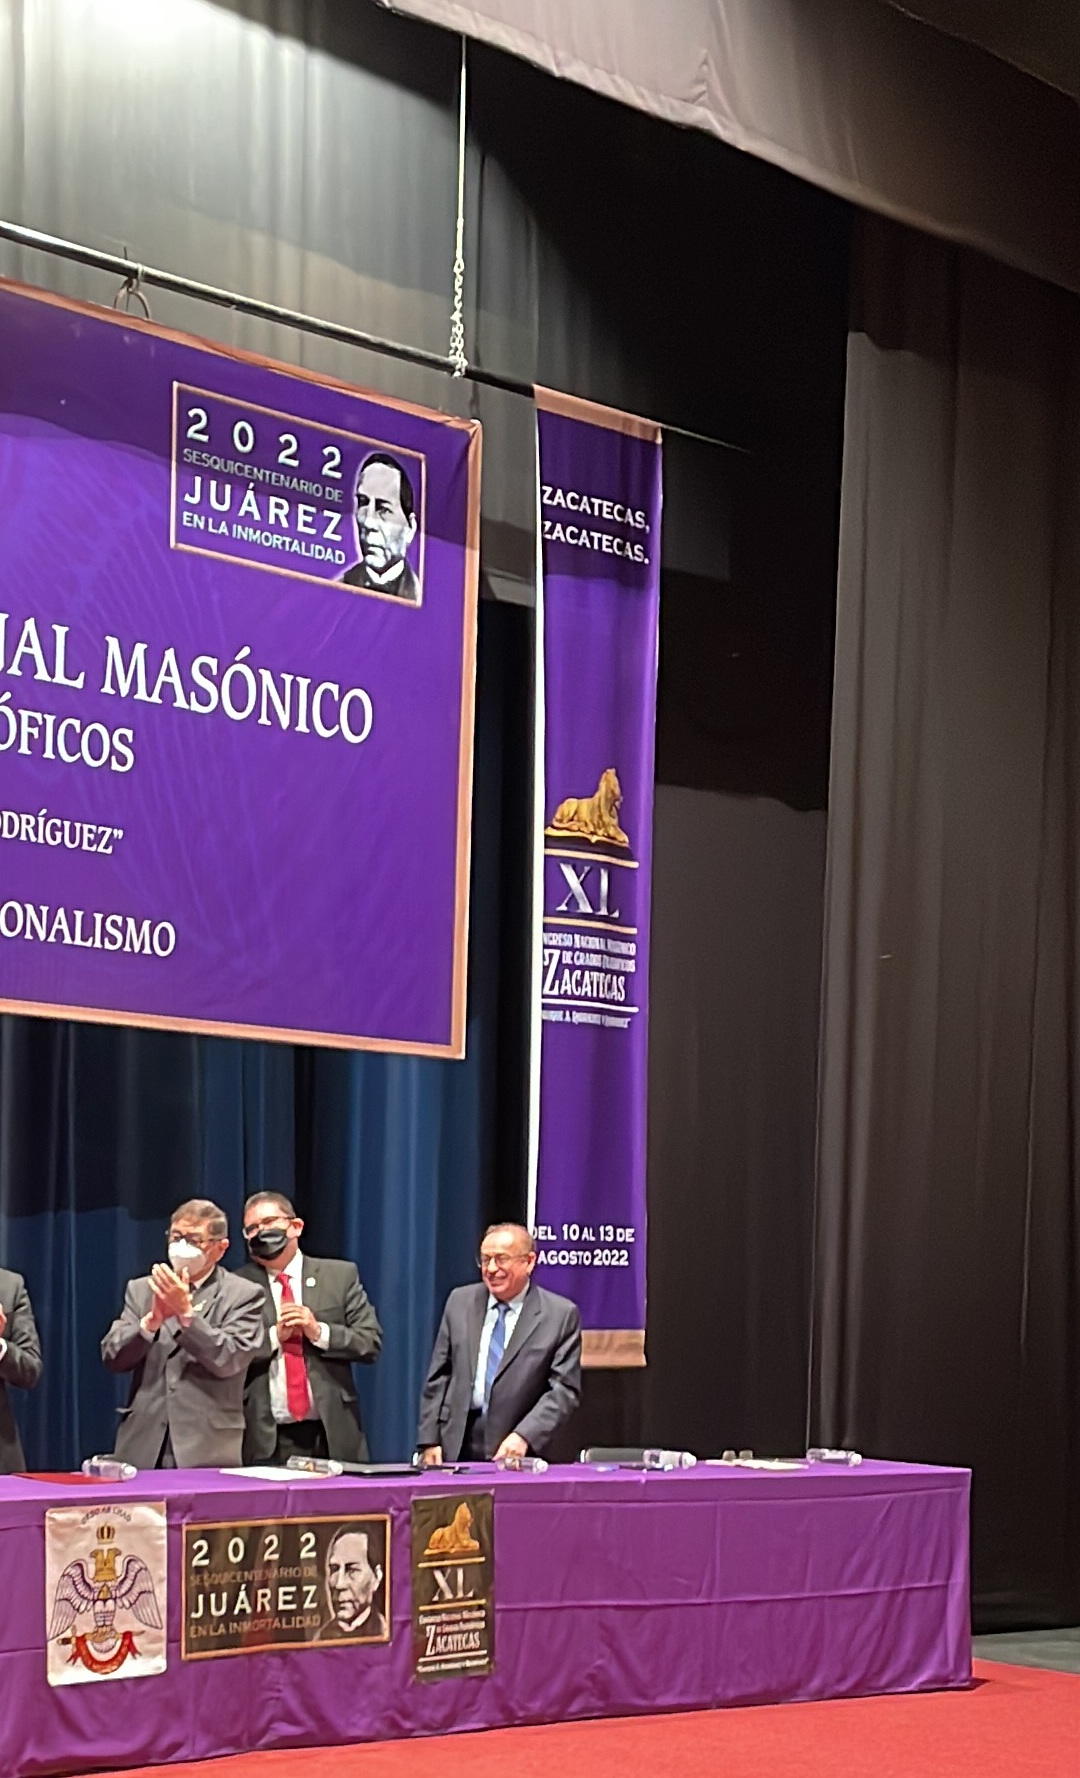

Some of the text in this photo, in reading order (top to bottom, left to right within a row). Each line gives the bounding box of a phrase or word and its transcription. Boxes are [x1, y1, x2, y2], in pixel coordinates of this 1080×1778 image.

[183, 448, 344, 503] SESQUICENTENARIO DE
[184, 475, 343, 541] JUÁREZ
[541, 485, 651, 534] ZACATECAS,
[182, 511, 346, 565] EN LA INMORTALIDAD
[542, 520, 650, 565] ZACATECAS.
[100, 634, 374, 745] MASÓNICO
[555, 862, 620, 919] XL
[542, 948, 626, 1003] ZACATECAS
[562, 1223, 580, 1241] 10
[581, 1226, 596, 1241] AL
[599, 1225, 614, 1242] 13
[616, 1228, 635, 1242] DE
[537, 1248, 629, 1266] AGOSTO 2022
[190, 1583, 318, 1619] JUÁREZ
[431, 1567, 475, 1602] XL
[189, 1614, 320, 1639] EN LA INMORTALIDAD
[425, 1624, 481, 1656] ZACATECAS
